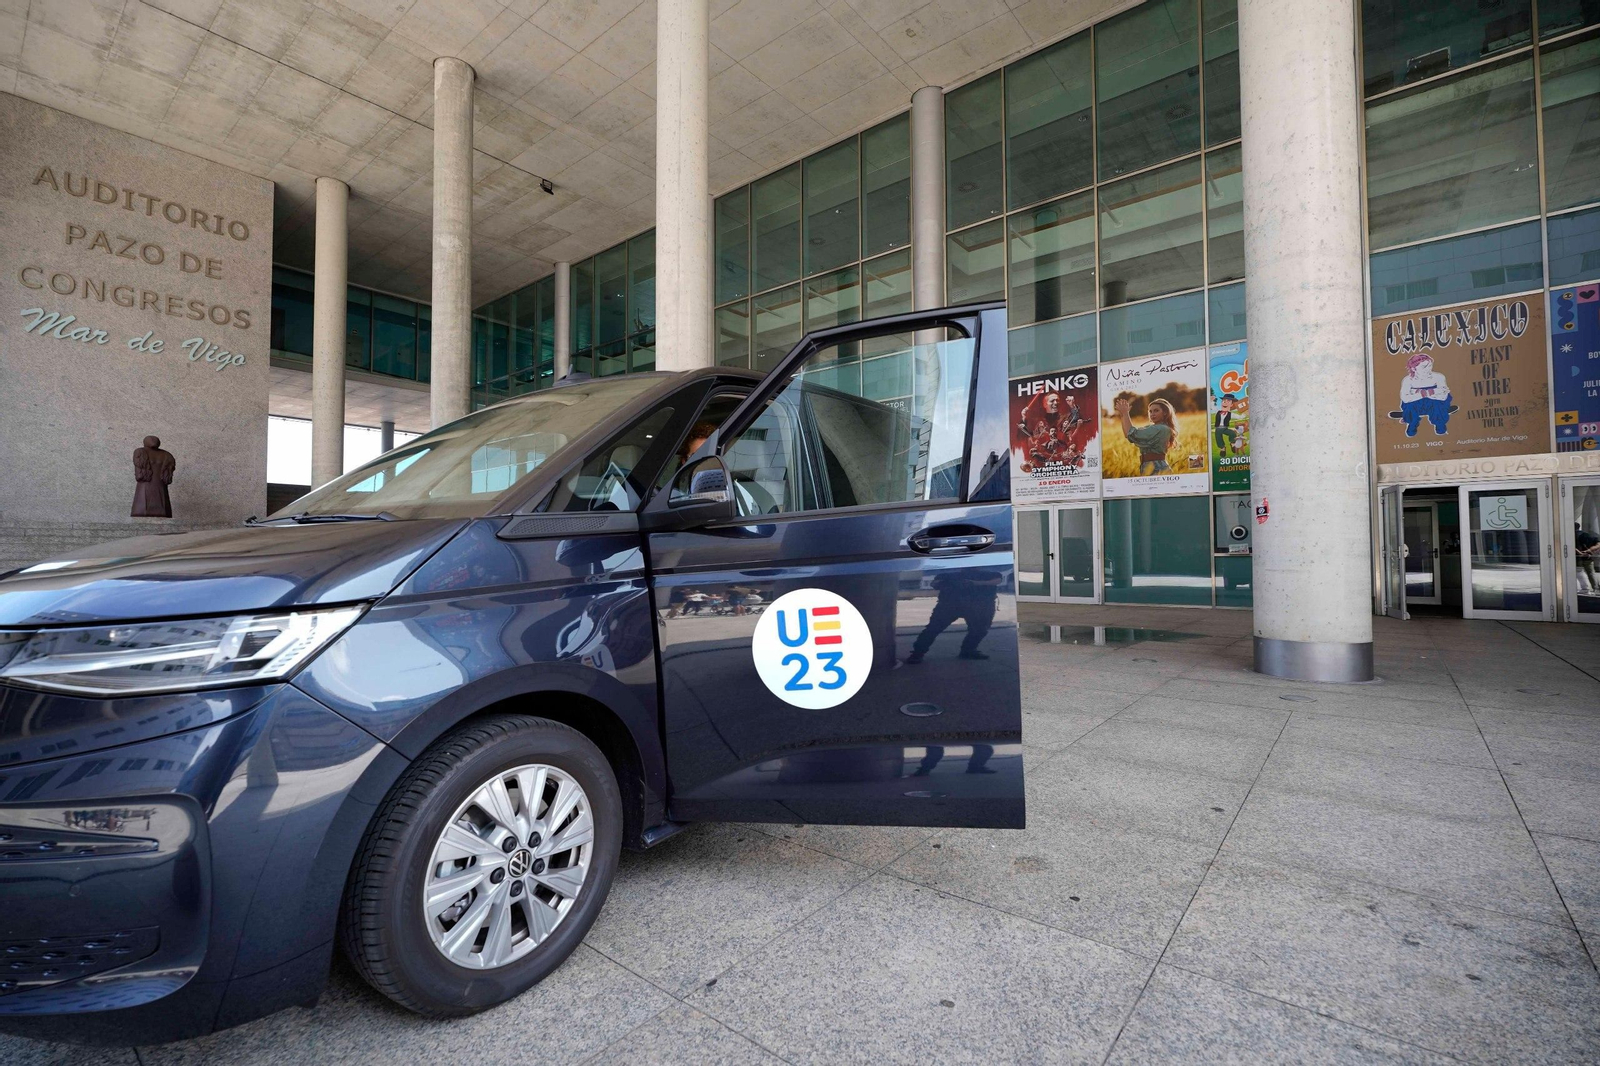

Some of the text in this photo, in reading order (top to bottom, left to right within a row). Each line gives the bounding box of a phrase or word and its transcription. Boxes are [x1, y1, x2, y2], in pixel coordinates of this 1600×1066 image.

[32, 165, 250, 242] AUDITORIO
[64, 222, 223, 280] PAZO DE
[16, 264, 252, 330] CONGRESOS
[1385, 300, 1530, 356] CALEXICO
[20, 307, 247, 372] Mar de Vigo
[1470, 344, 1513, 365] FEAST
[1106, 358, 1198, 382] Niña Pastori
[1482, 363, 1500, 380] OF
[1017, 373, 1089, 397] HENKO
[1106, 378, 1142, 388] CAMINO
[1472, 378, 1511, 397] WIRE
[1587, 389, 1598, 397] LA
[1466, 405, 1520, 420] ANNIVERSARY
[1482, 418, 1504, 428] TOUR
[1393, 442, 1420, 450] 11.10.23
[1456, 437, 1486, 445] Auditorio
[1511, 434, 1528, 442] Vigo
[1031, 465, 1077, 473] SYMPHONY
[1219, 457, 1231, 465] 30
[1383, 460, 1496, 479] AUDITORIO
[1503, 456, 1560, 473] PAZO
[1030, 469, 1079, 478] ORCHESTRA
[776, 606, 843, 648] UE
[781, 651, 847, 691] 23
